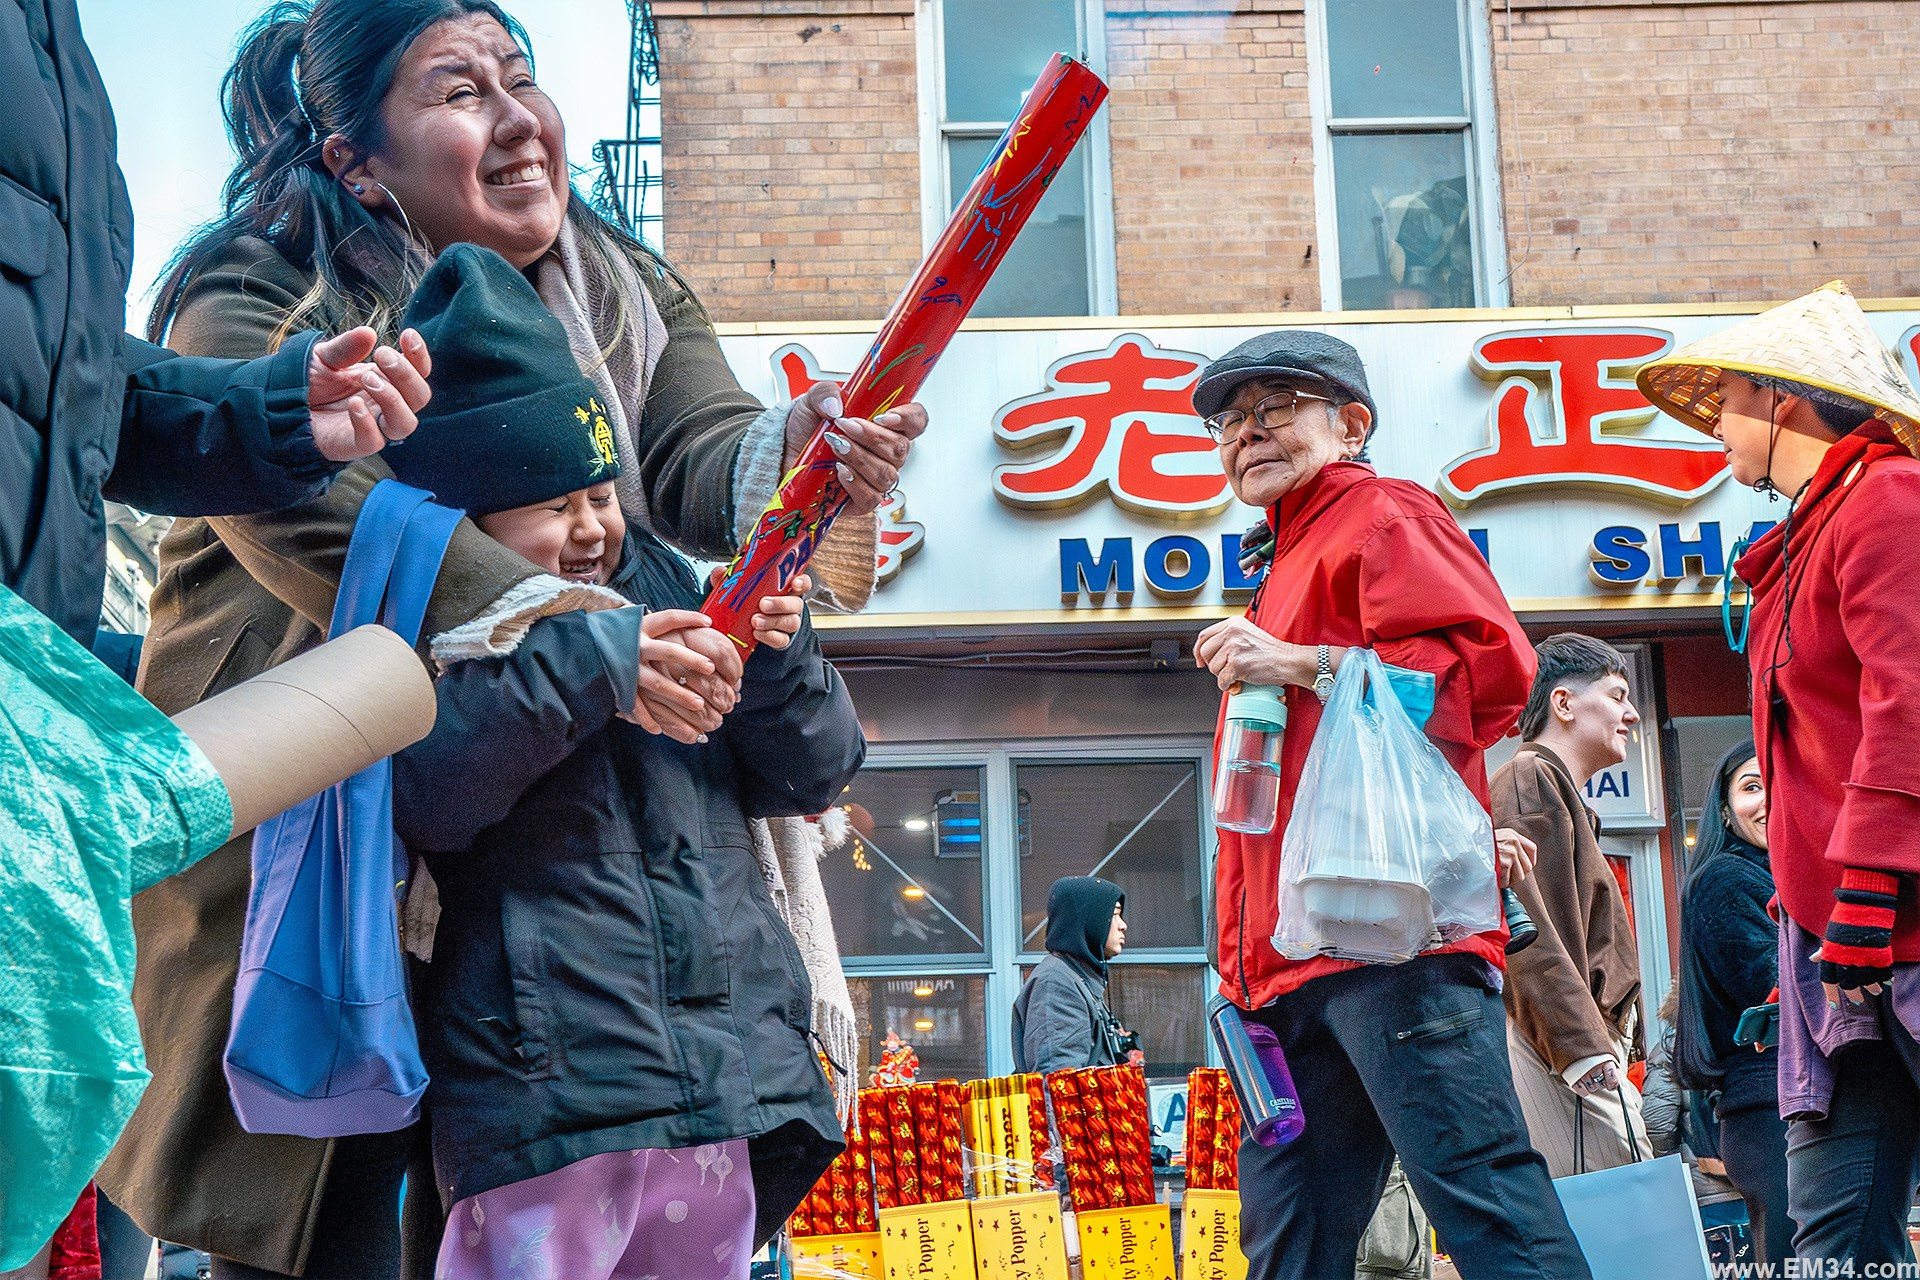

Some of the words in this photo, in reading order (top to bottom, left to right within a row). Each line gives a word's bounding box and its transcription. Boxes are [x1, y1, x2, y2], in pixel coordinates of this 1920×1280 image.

[918, 1218, 935, 1274] Popper
[1010, 1209, 1029, 1265] Popper
[1119, 1217, 1138, 1265] Popper
[1208, 1209, 1229, 1263] Popper
